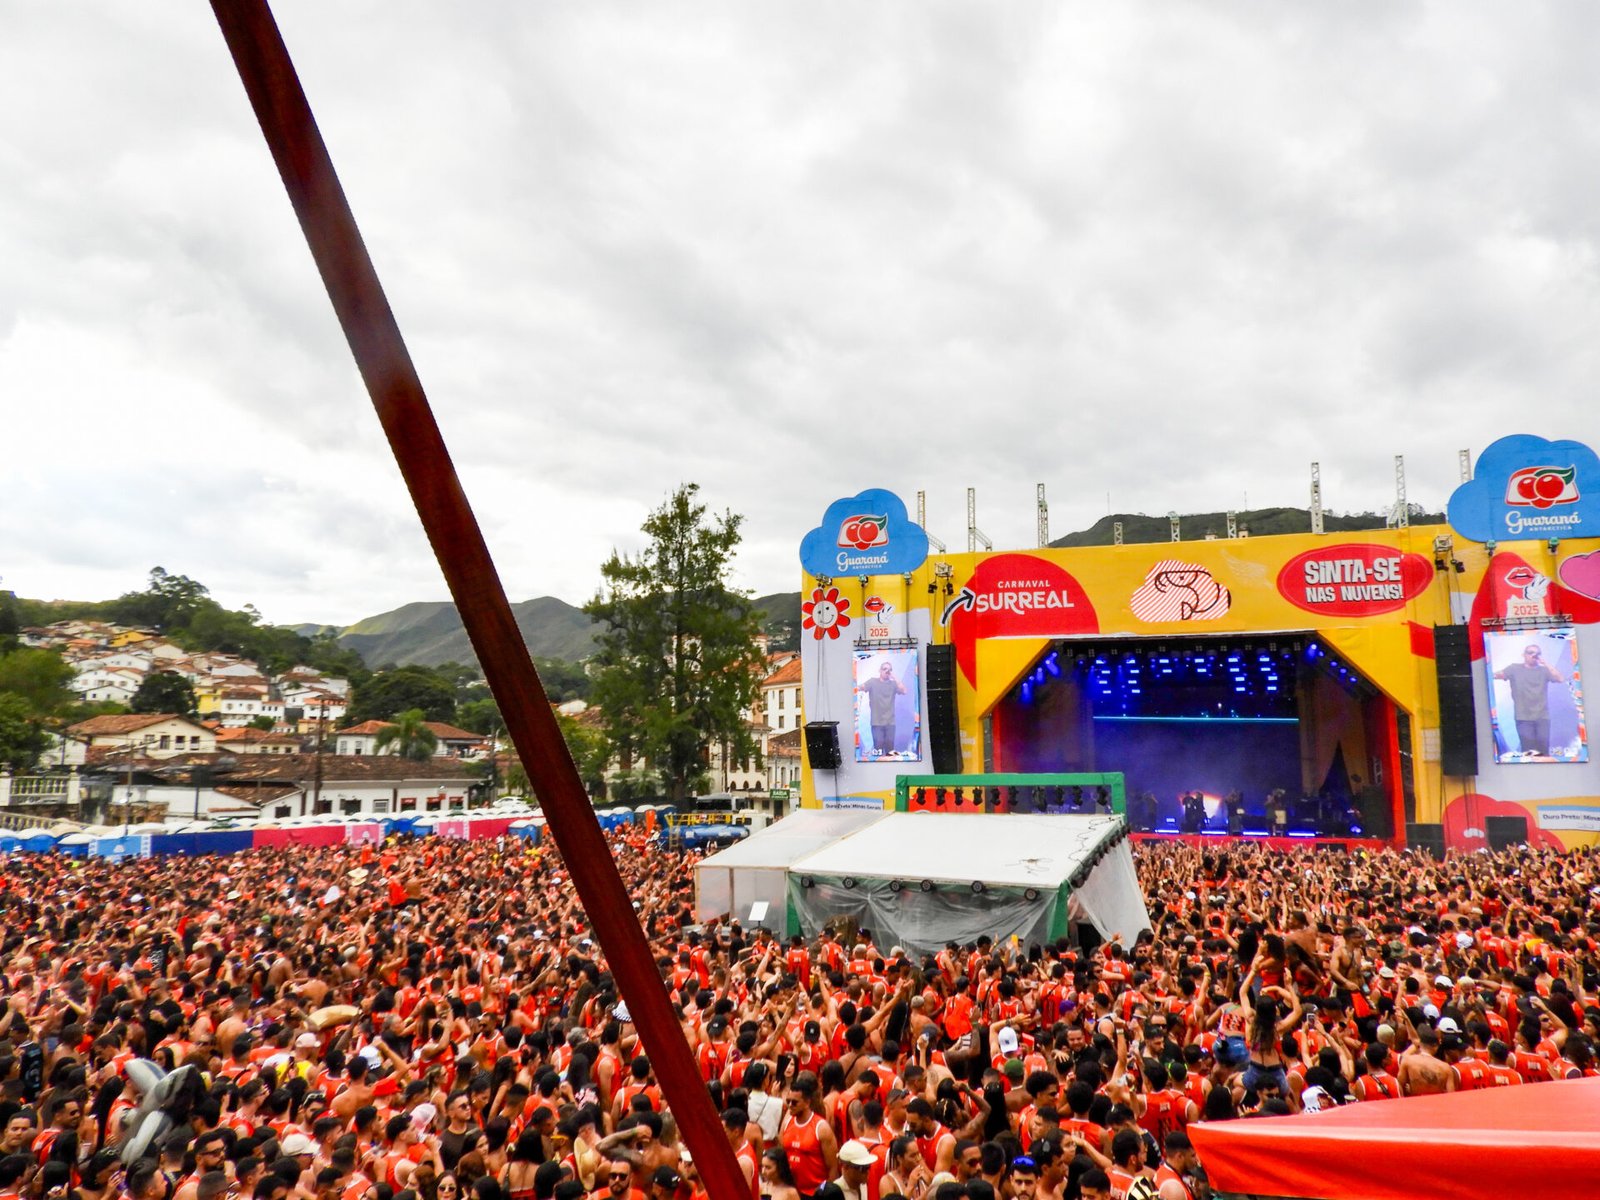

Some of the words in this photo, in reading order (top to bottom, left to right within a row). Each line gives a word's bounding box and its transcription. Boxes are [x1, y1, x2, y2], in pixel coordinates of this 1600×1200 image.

[1505, 510, 1582, 534] Guaraná
[836, 551, 889, 572] Guaraná
[997, 580, 1051, 588] CARNAVAL
[1305, 586, 1336, 603] NAS
[1341, 583, 1404, 601] NUVENS!
[976, 590, 1075, 615] SURREAL
[1513, 605, 1540, 616] 2025
[869, 628, 889, 637] 2025
